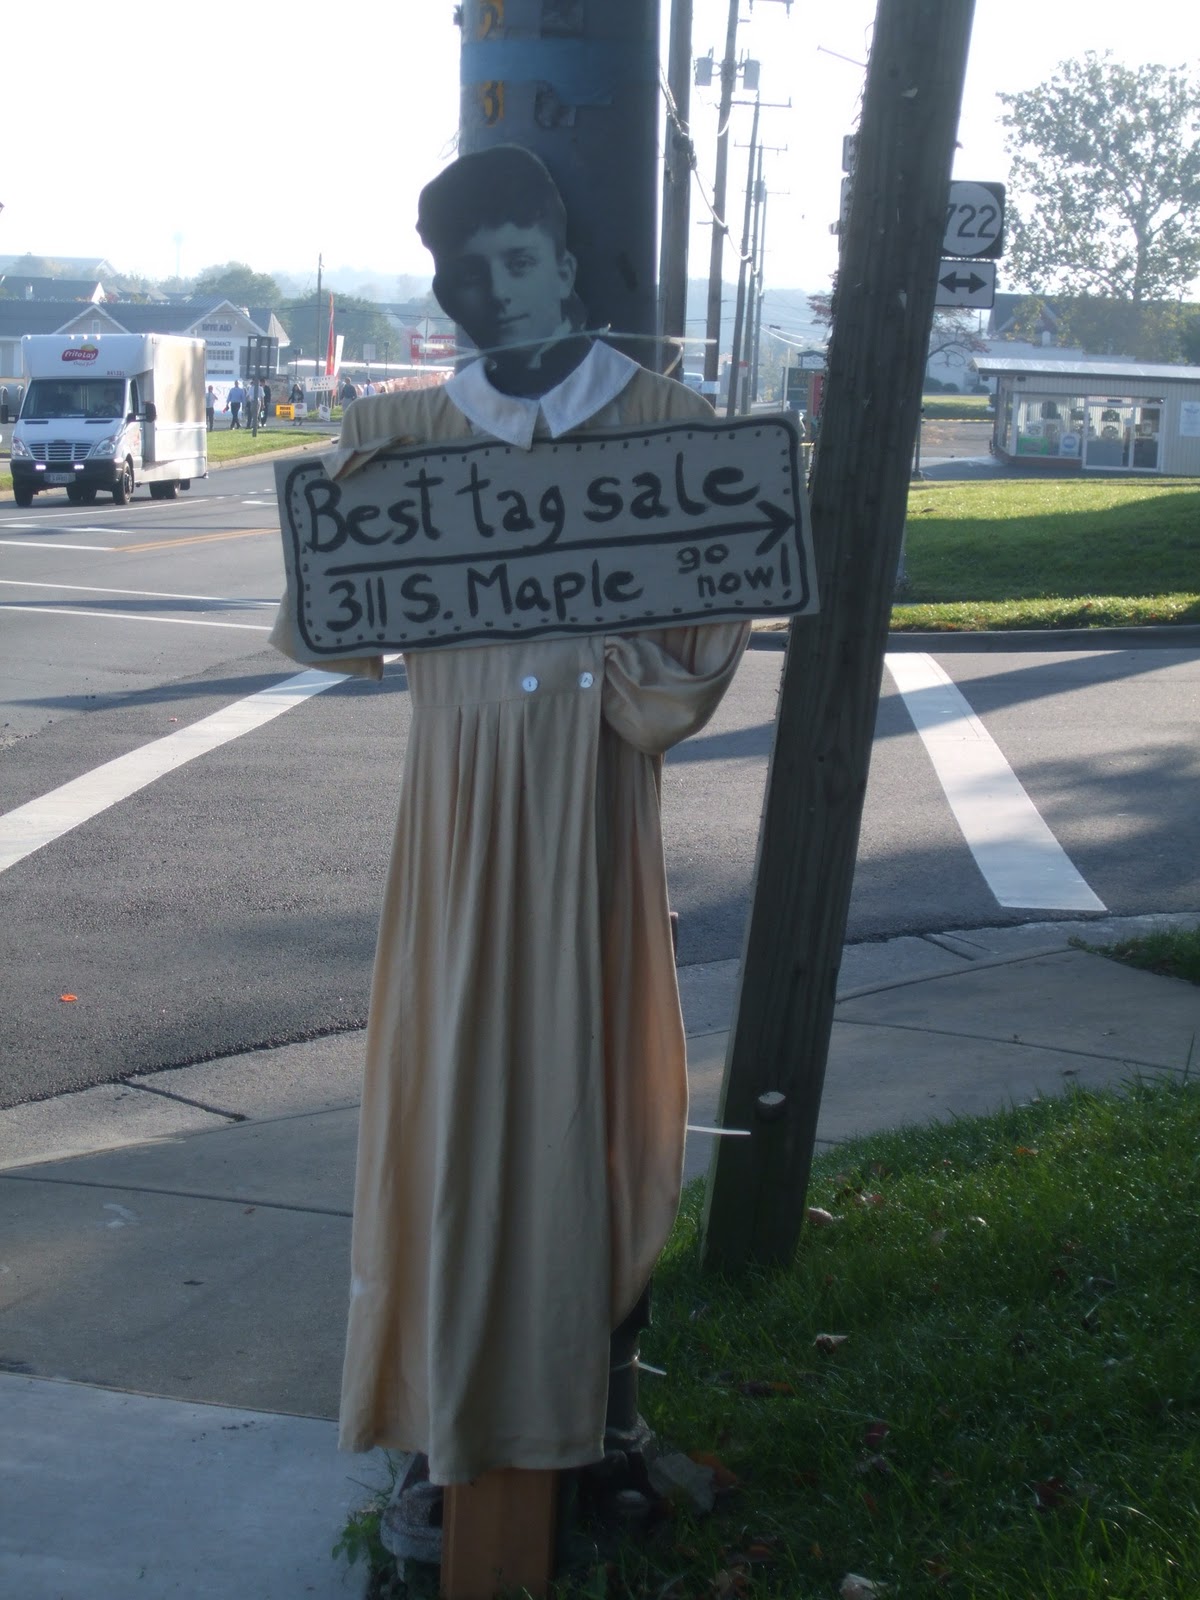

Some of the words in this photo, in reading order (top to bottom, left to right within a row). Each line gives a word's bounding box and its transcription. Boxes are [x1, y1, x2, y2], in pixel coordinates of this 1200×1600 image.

[945, 203, 997, 238] 722
[202, 323, 218, 331] RITE
[219, 324, 232, 332] AID
[304, 468, 444, 552] Best
[455, 462, 565, 548] tag
[584, 451, 760, 523] sale
[676, 543, 729, 575] go
[697, 543, 792, 600] now!
[326, 576, 388, 632] 311
[401, 572, 454, 623] S.
[466, 558, 644, 622] Maple
